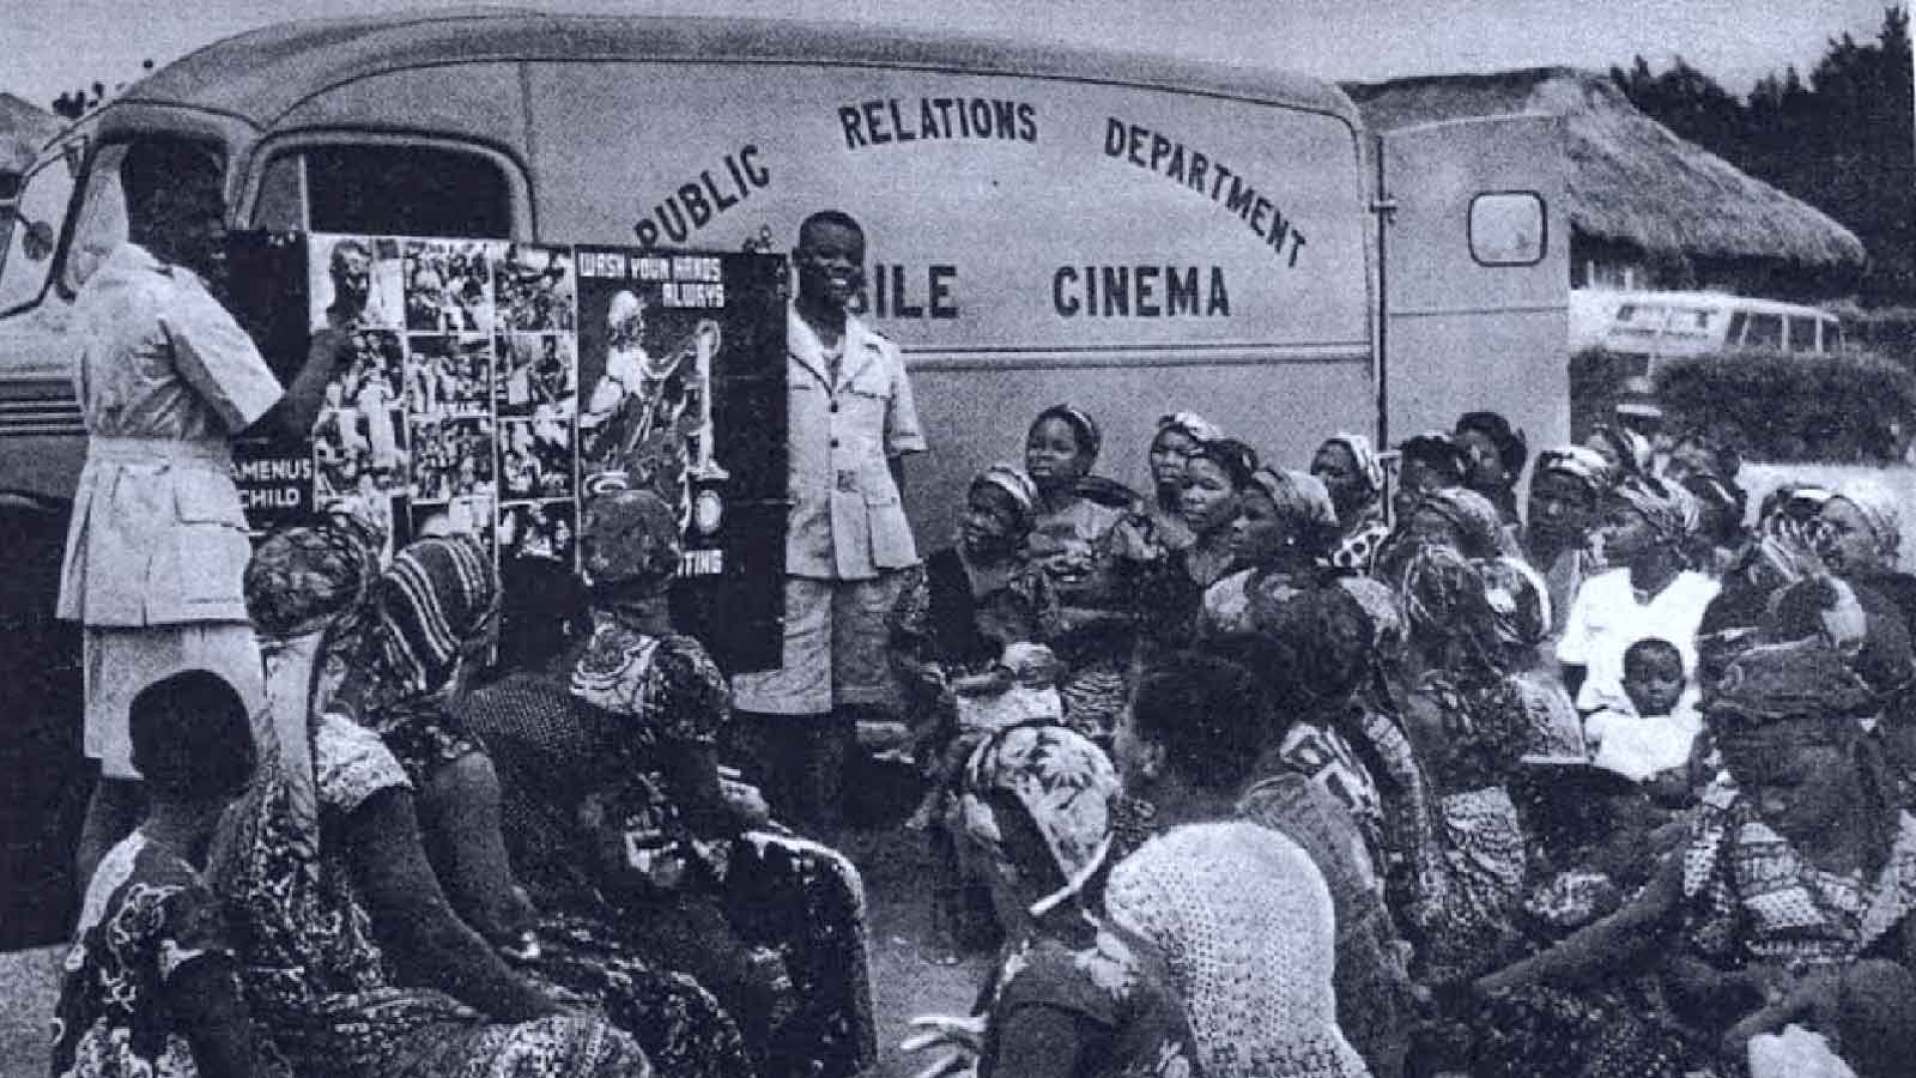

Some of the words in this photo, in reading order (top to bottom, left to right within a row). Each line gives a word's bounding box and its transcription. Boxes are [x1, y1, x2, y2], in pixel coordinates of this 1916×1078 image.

[634, 144, 769, 249] PUBLIC
[838, 97, 1037, 150] RELATIONS
[1105, 116, 1306, 268] DEPARTMENT
[578, 252, 625, 277] WASH
[631, 257, 670, 280] YOUR
[1053, 265, 1231, 317] CINEMA
